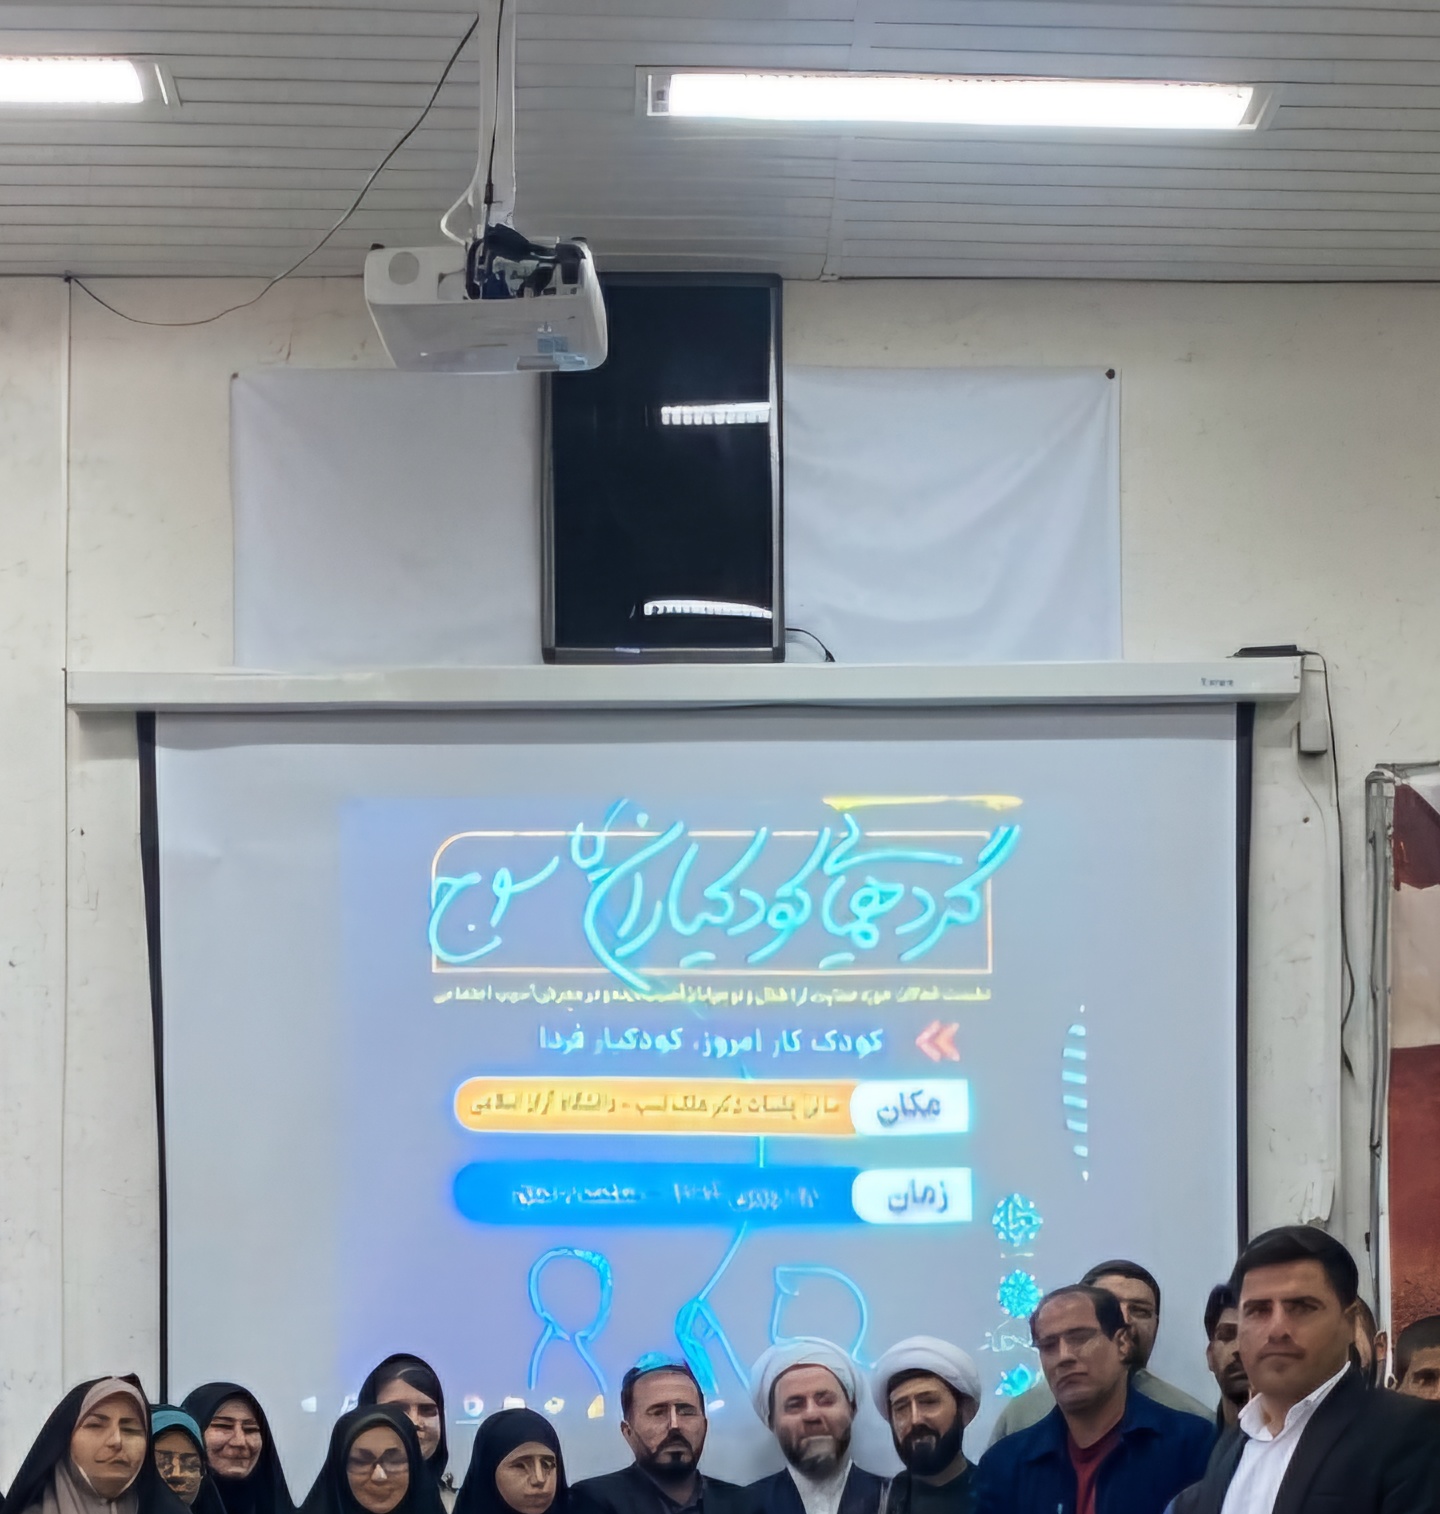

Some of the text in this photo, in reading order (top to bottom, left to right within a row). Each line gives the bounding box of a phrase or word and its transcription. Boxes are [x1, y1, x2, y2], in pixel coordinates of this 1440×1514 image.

[539, 1023, 585, 1055] فردا
[772, 1028, 803, 1058] کار
[810, 1028, 884, 1059] کودک
[876, 1089, 942, 1127] مکان
[887, 1178, 948, 1214] زمان
